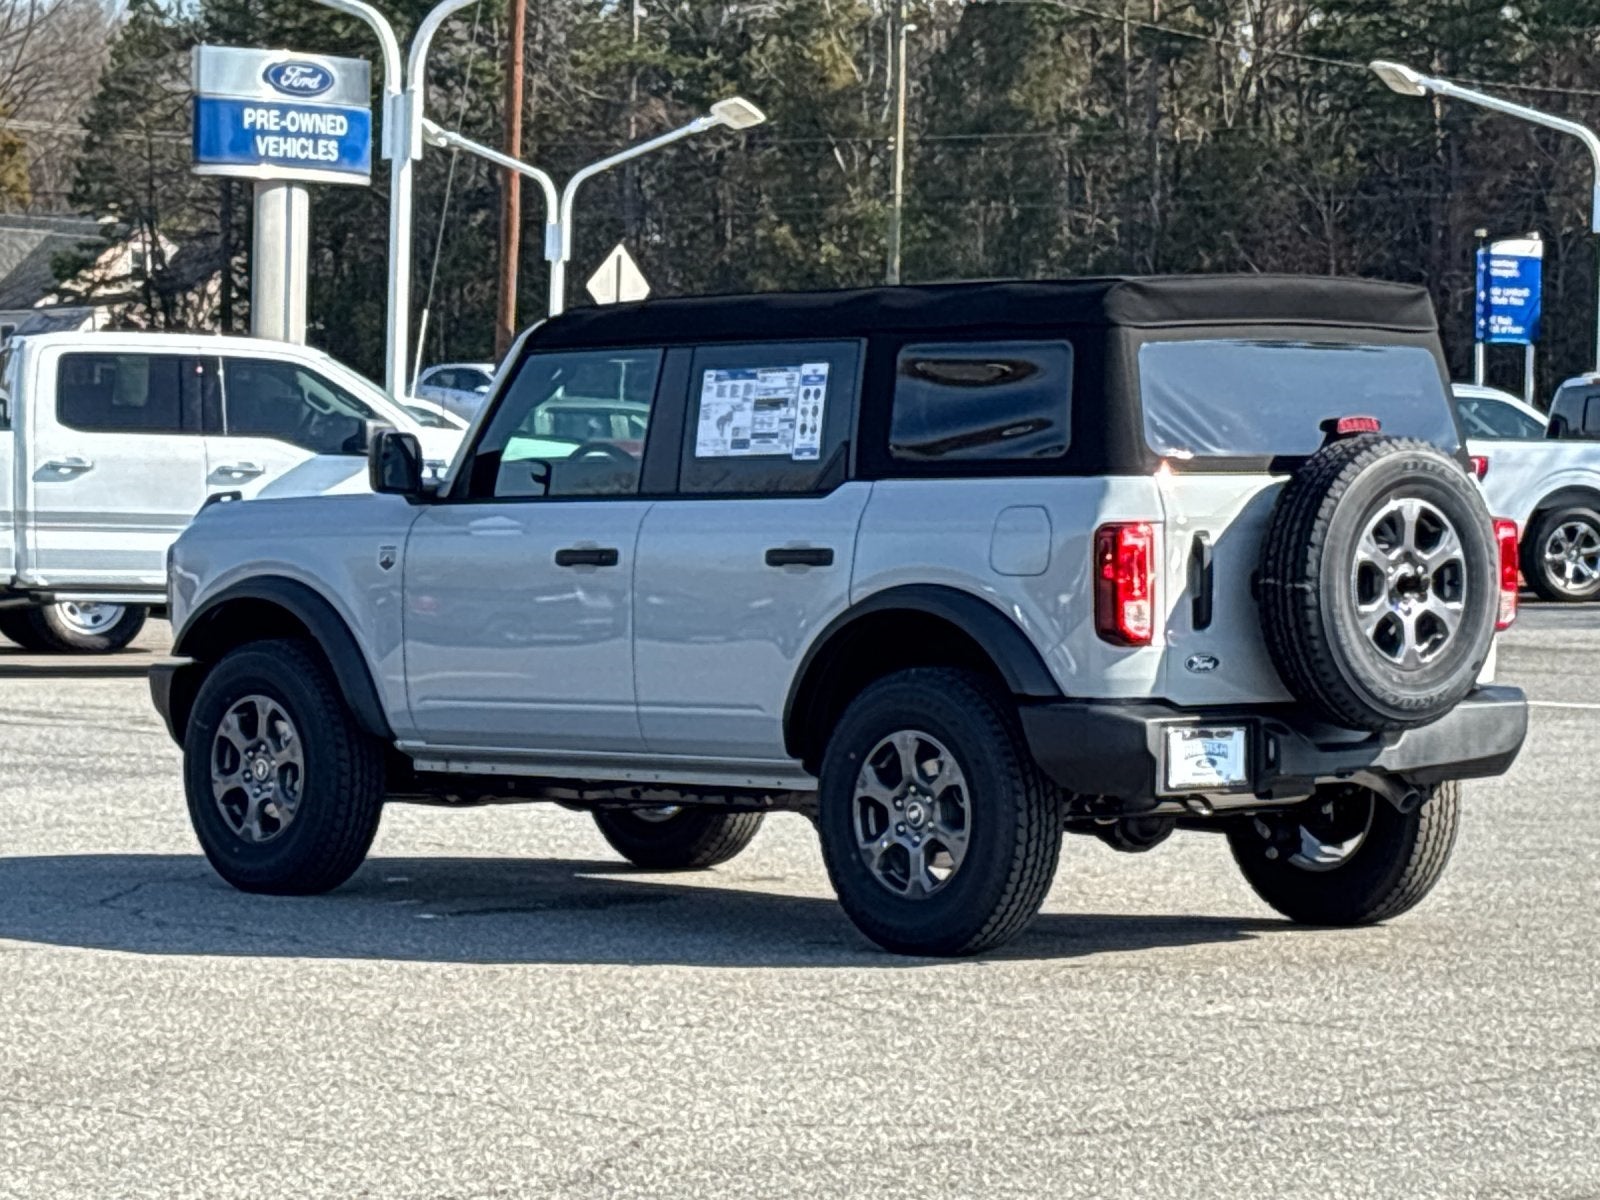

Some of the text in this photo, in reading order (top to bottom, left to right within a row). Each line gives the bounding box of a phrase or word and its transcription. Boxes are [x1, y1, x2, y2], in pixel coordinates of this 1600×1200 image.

[276, 63, 325, 91] Ford
[243, 107, 348, 137] PRE-OWNED
[256, 135, 339, 162] VEHICLES
